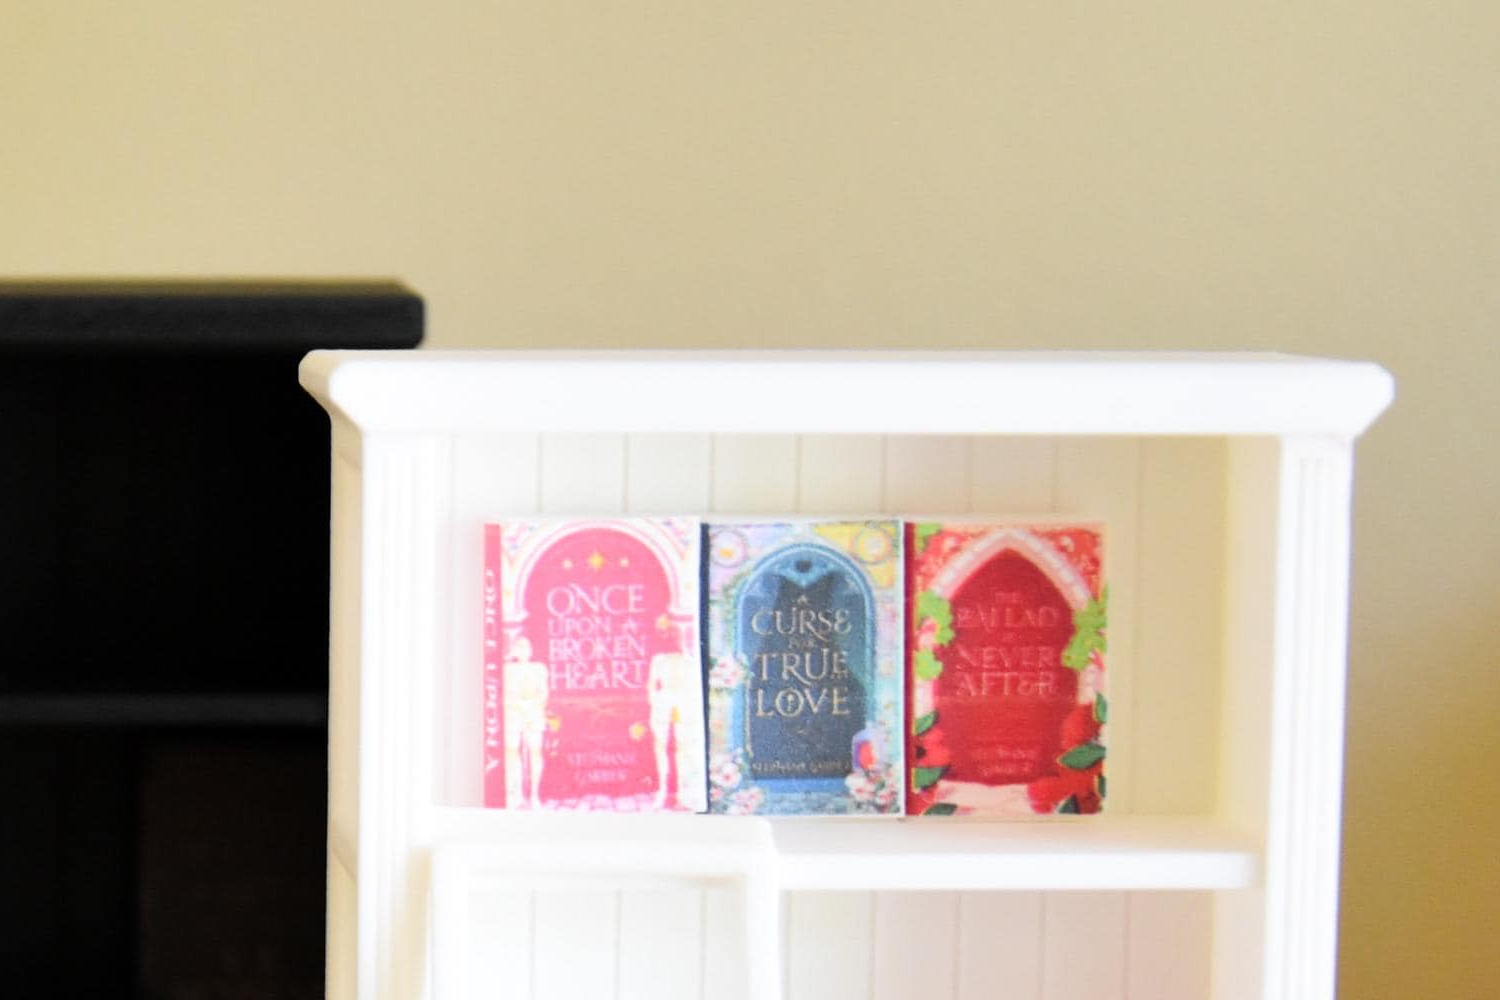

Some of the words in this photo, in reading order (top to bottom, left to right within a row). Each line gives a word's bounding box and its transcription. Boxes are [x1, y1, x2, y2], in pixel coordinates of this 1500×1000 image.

[546, 582, 644, 617] ONCE
[548, 616, 612, 637] UPON
[621, 617, 640, 634] A
[751, 606, 852, 642] CURSE
[548, 634, 646, 660] BROKEN
[955, 642, 1055, 670] NEVER
[550, 659, 644, 690] HEART
[755, 648, 848, 686] TRUE
[955, 671, 1056, 697] AFTER
[756, 687, 849, 717] LOVE
